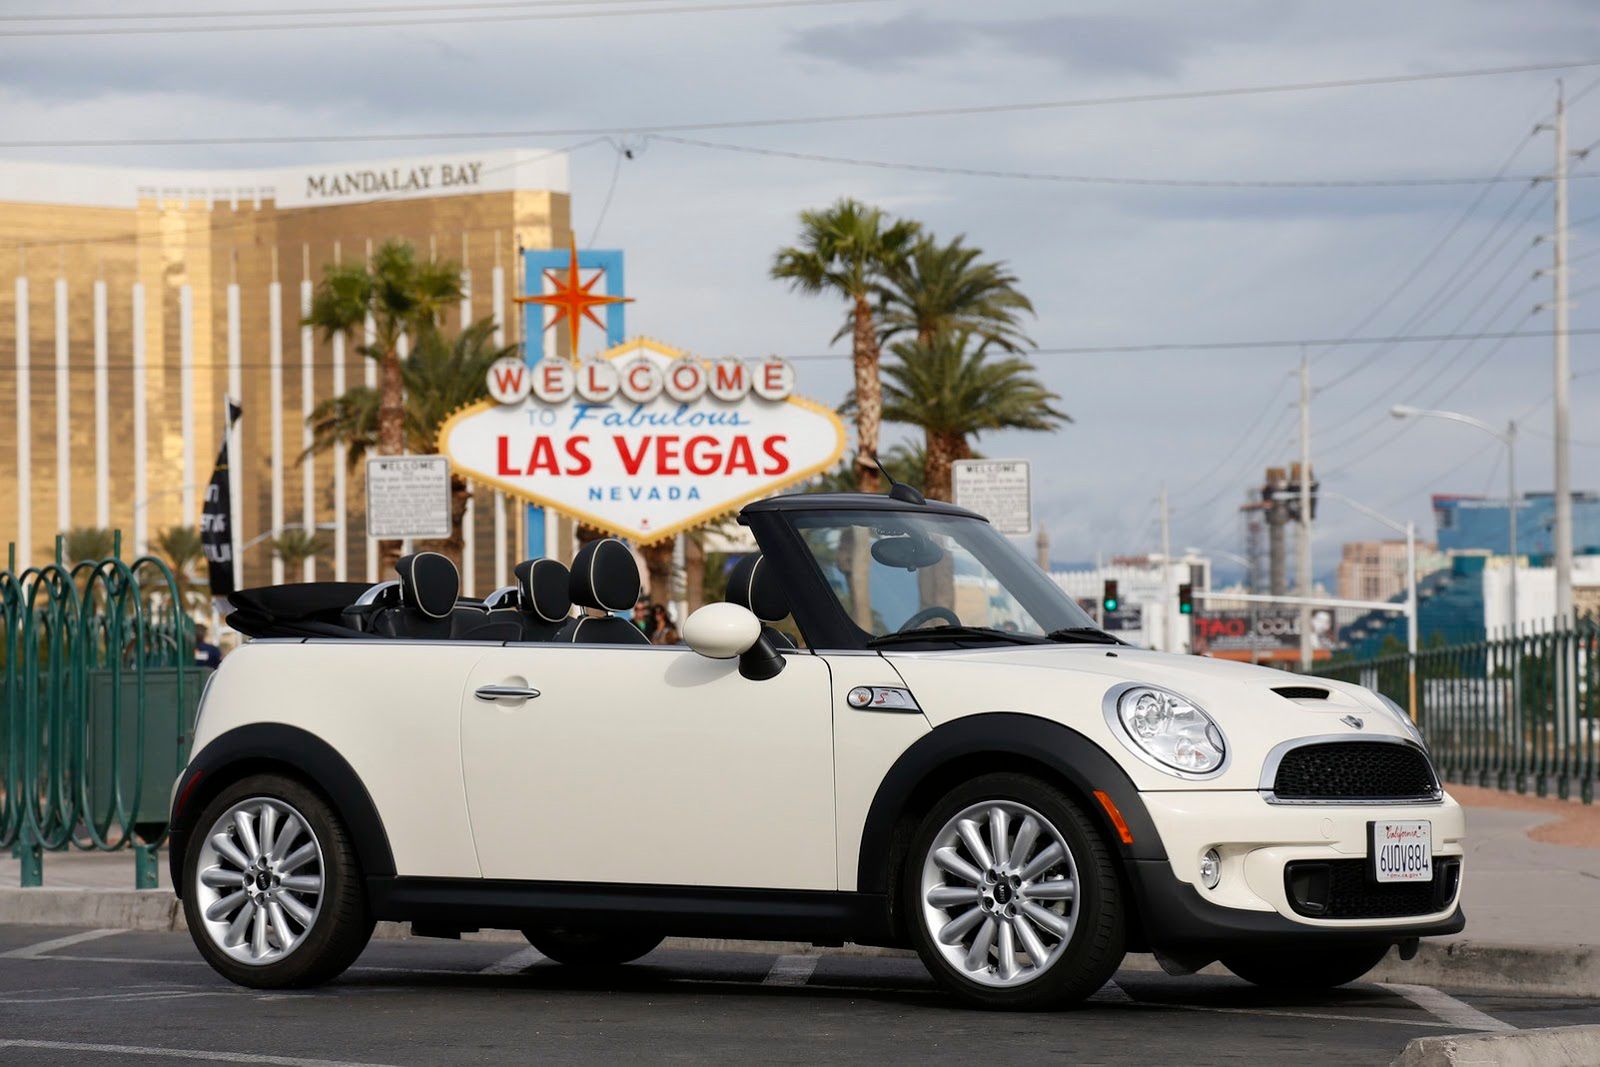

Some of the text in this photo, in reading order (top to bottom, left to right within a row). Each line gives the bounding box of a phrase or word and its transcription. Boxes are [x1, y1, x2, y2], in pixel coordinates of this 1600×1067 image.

[307, 161, 482, 198] MANDALAY BAY
[494, 365, 784, 394] WELCOME
[526, 404, 751, 430] TO Fabulous
[497, 435, 790, 477] LAS VEGAS
[588, 487, 701, 501] NEVADA
[1195, 617, 1246, 637] TAO
